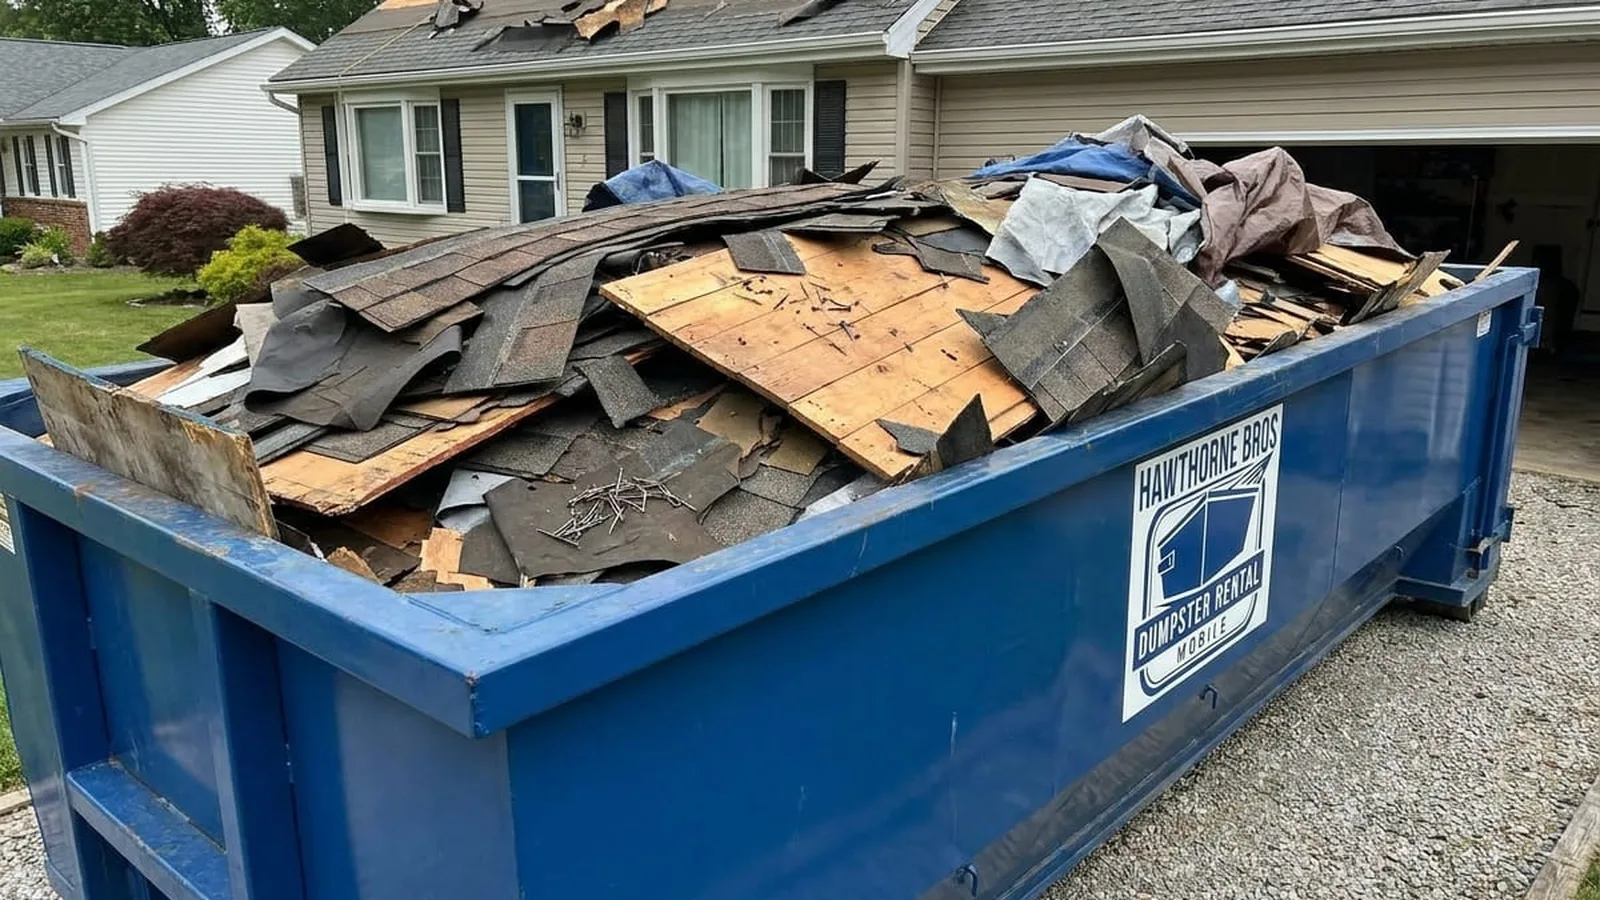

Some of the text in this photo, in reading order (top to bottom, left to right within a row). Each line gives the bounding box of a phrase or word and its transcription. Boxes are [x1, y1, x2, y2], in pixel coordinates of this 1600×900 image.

[1139, 412, 1278, 512] HAWTHORNE BROS
[1138, 561, 1259, 659] DUMPSTER RENTAL
[1176, 616, 1227, 664] MOBILE
